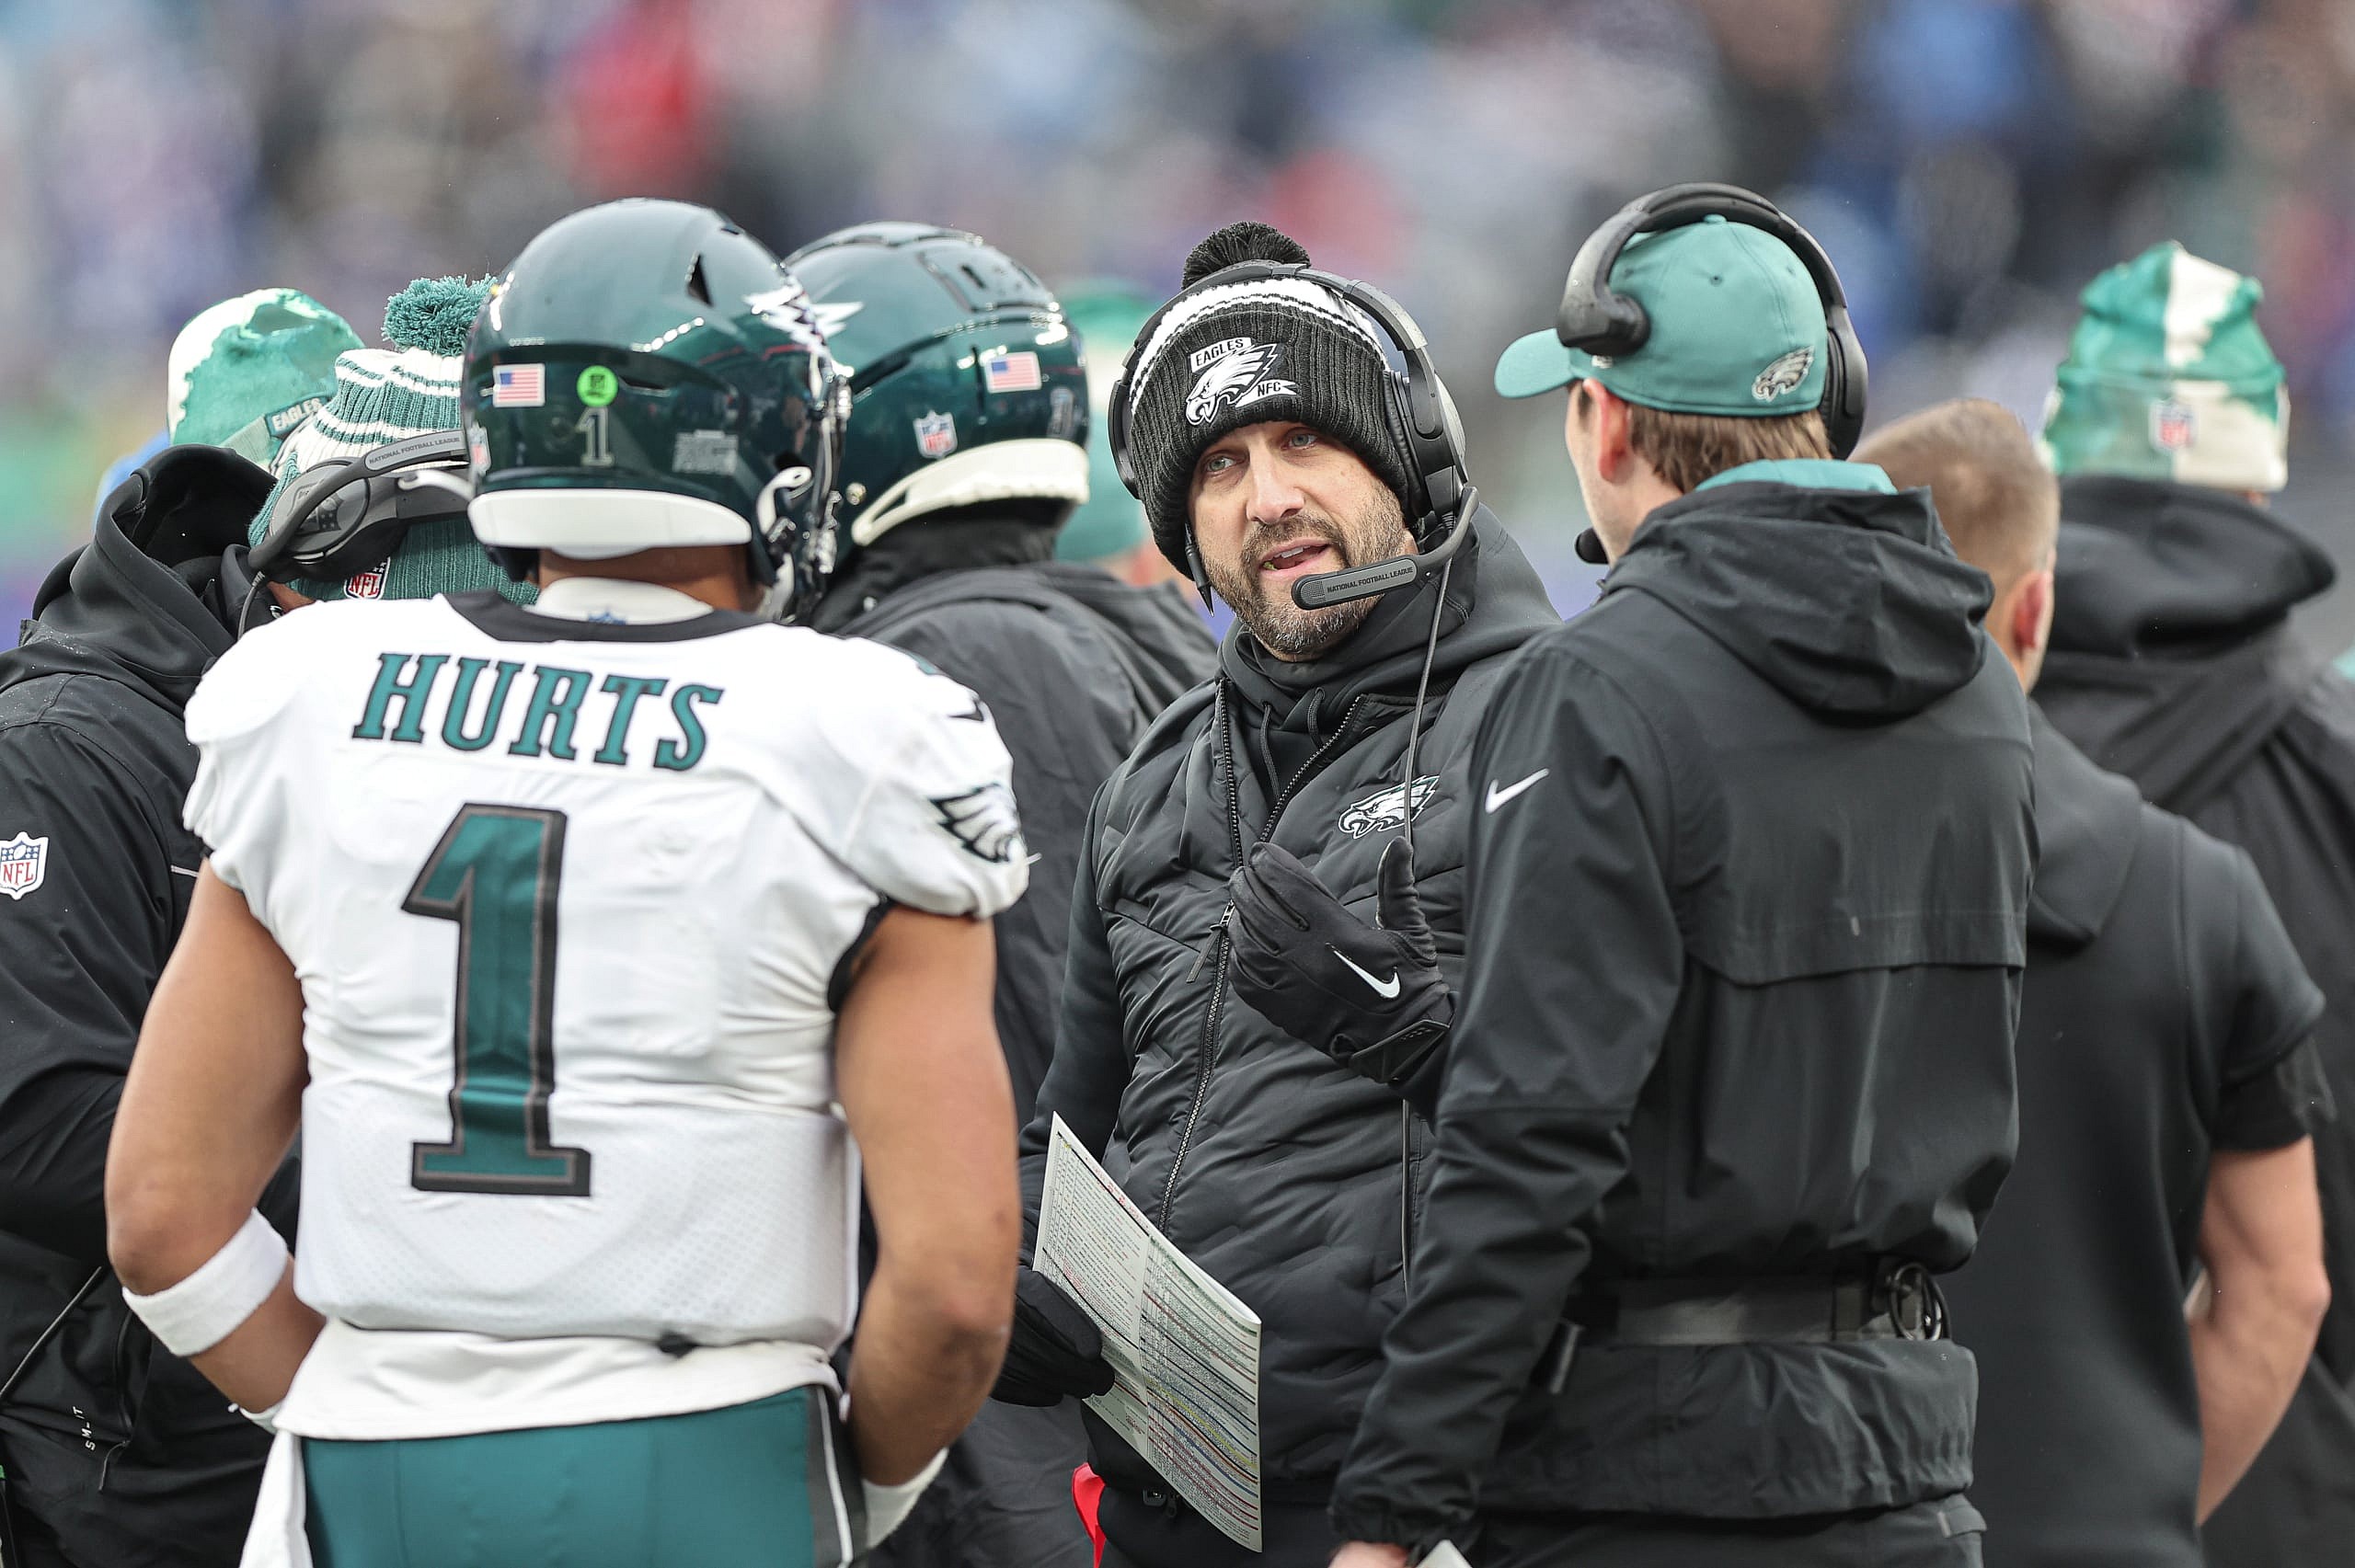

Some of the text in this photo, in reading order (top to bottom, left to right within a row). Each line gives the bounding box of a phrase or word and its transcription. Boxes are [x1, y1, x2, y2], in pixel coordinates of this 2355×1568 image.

[1196, 338, 1244, 367] EAGLES
[1257, 381, 1281, 397] NFC
[271, 397, 323, 431] EAGLES
[575, 405, 615, 466] 1
[369, 450, 401, 464] NATIONAL
[401, 441, 435, 454] FOOTBALL
[349, 573, 379, 599] NFL
[1327, 580, 1358, 594] NATIONAL
[1358, 573, 1390, 587] FOOTBALL
[351, 653, 725, 772] HURTS
[3, 861, 34, 885] NFL
[401, 803, 592, 1197] 1
